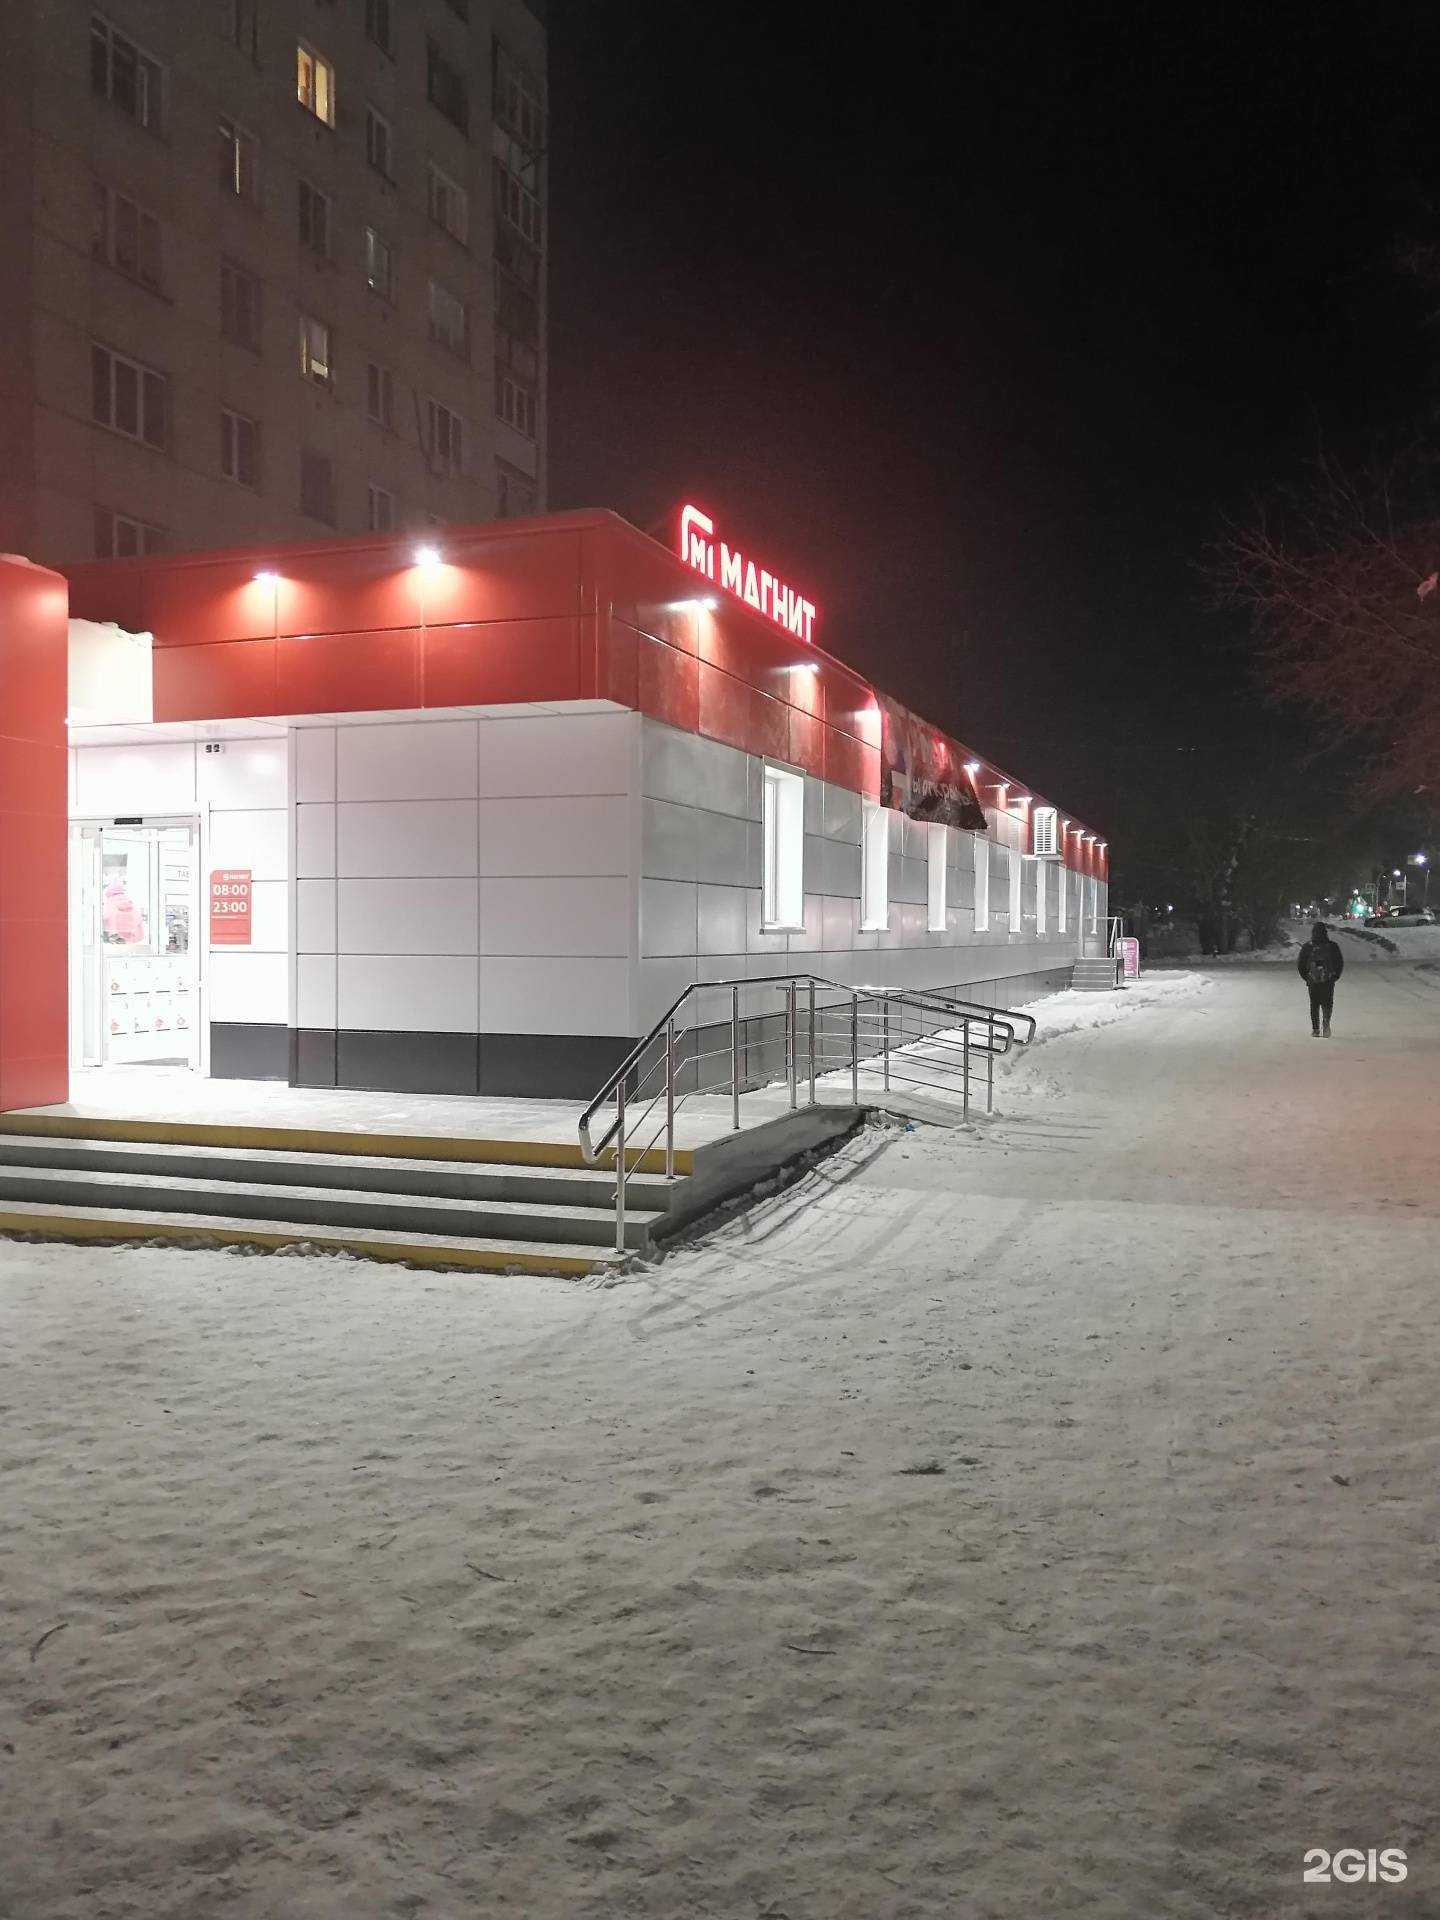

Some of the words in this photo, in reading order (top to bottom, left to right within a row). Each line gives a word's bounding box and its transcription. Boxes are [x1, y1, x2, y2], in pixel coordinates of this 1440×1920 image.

[720, 542, 816, 644] МАГНИТ
[213, 884, 248, 896] 08:00
[213, 901, 248, 913] 23:00
